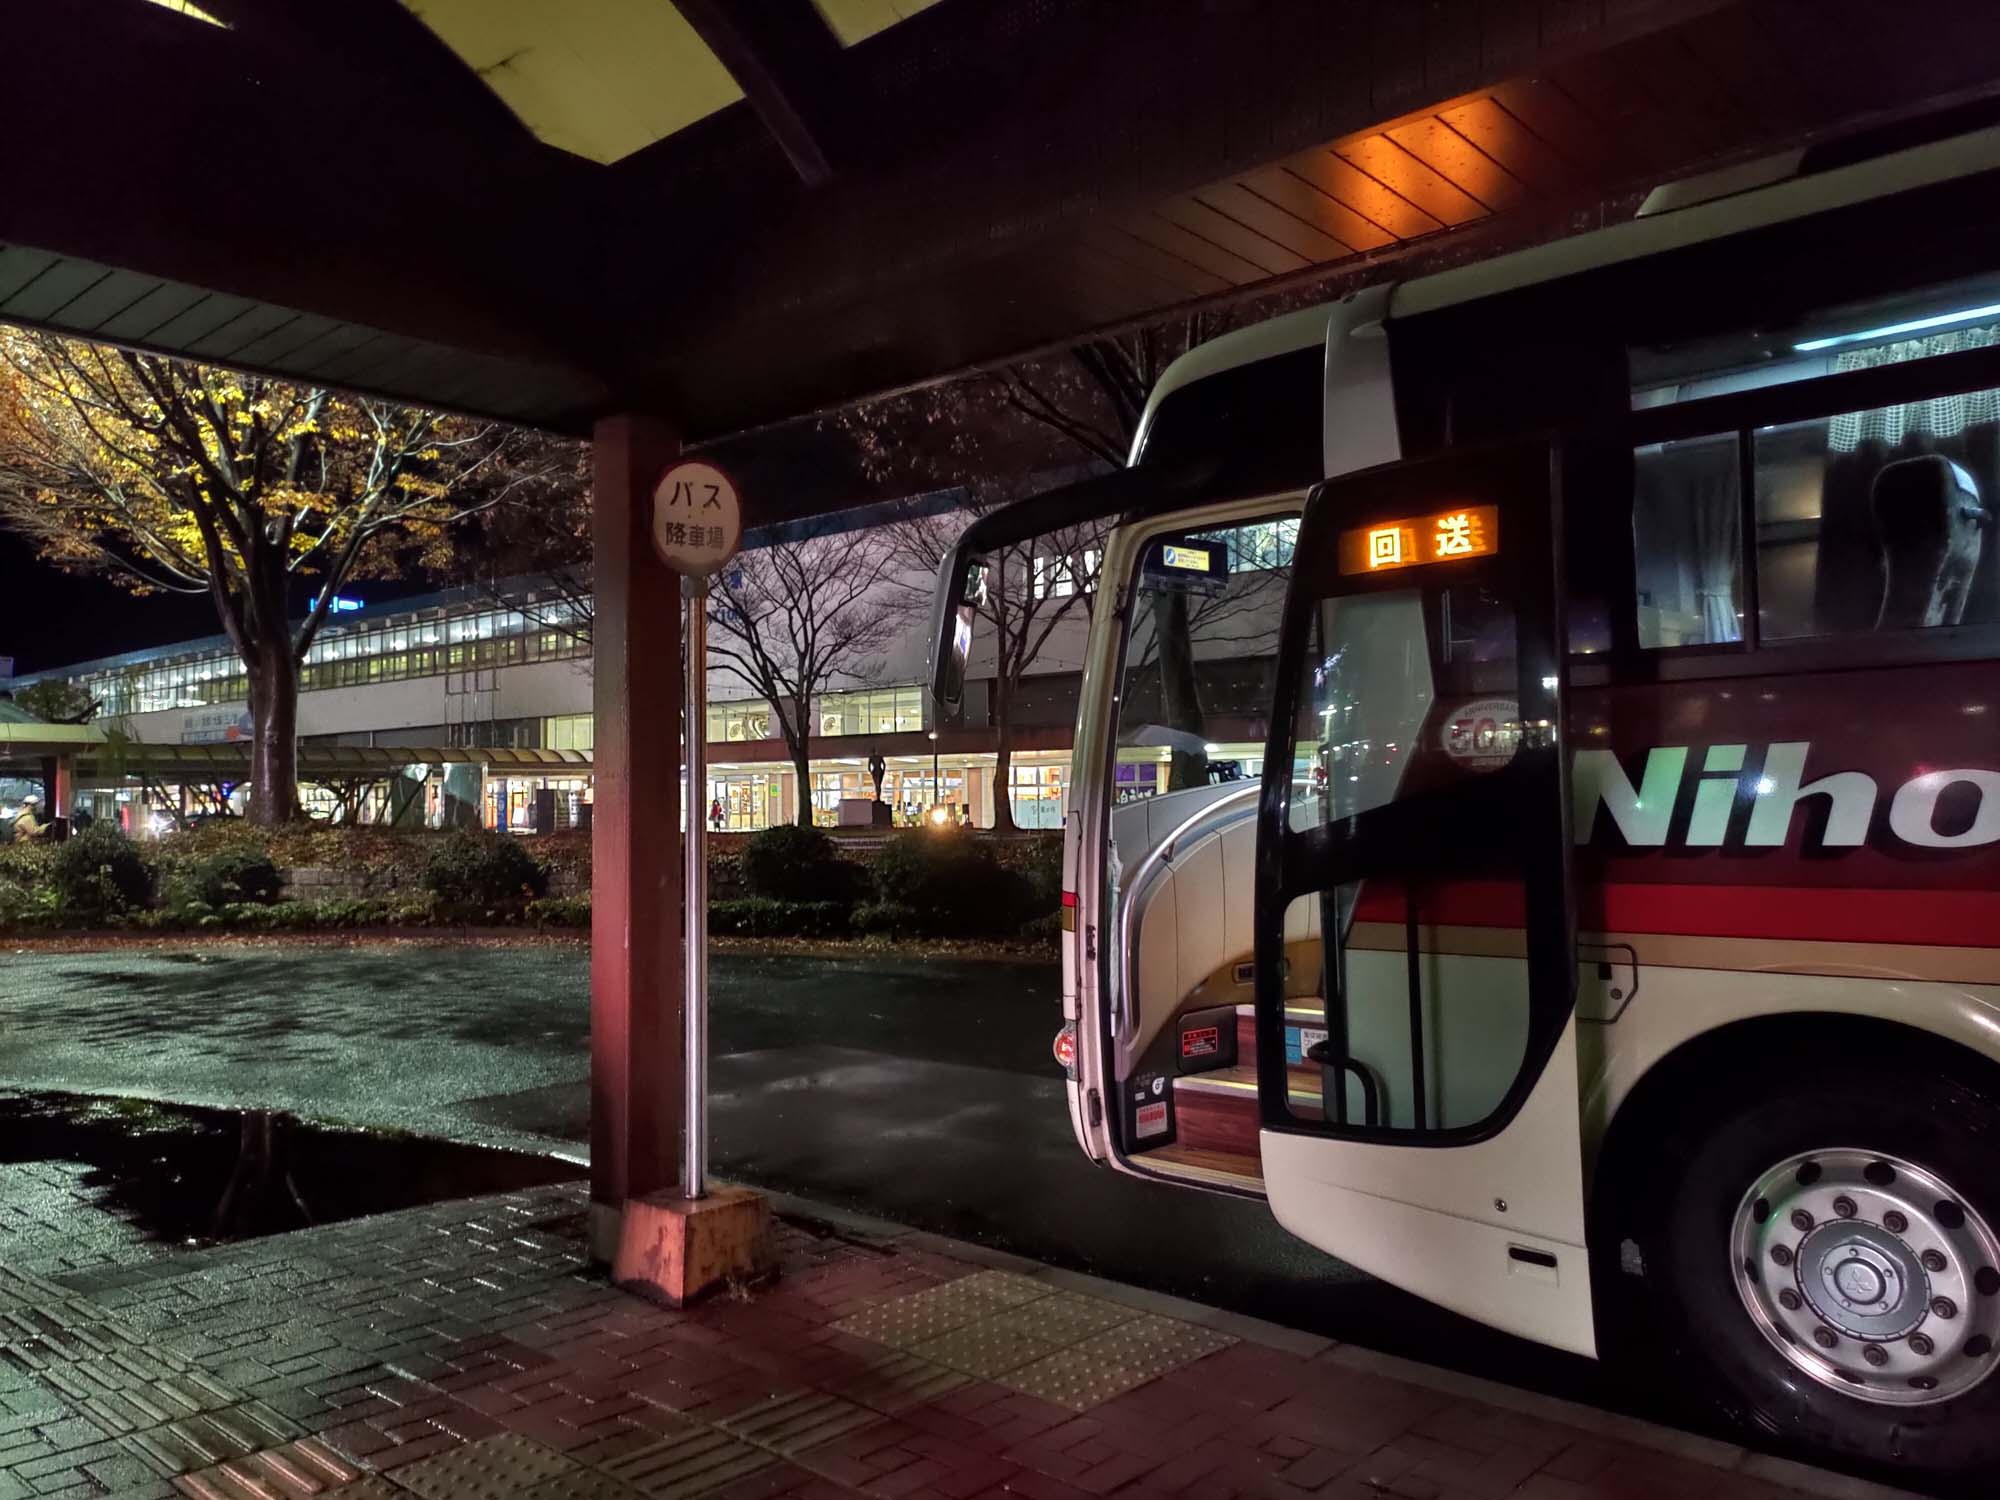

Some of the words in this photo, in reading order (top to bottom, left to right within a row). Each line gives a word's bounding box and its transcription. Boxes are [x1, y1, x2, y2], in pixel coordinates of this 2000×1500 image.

[670, 481, 721, 510] バス
[665, 522, 724, 550] 降車場
[1369, 514, 1473, 568] 回送
